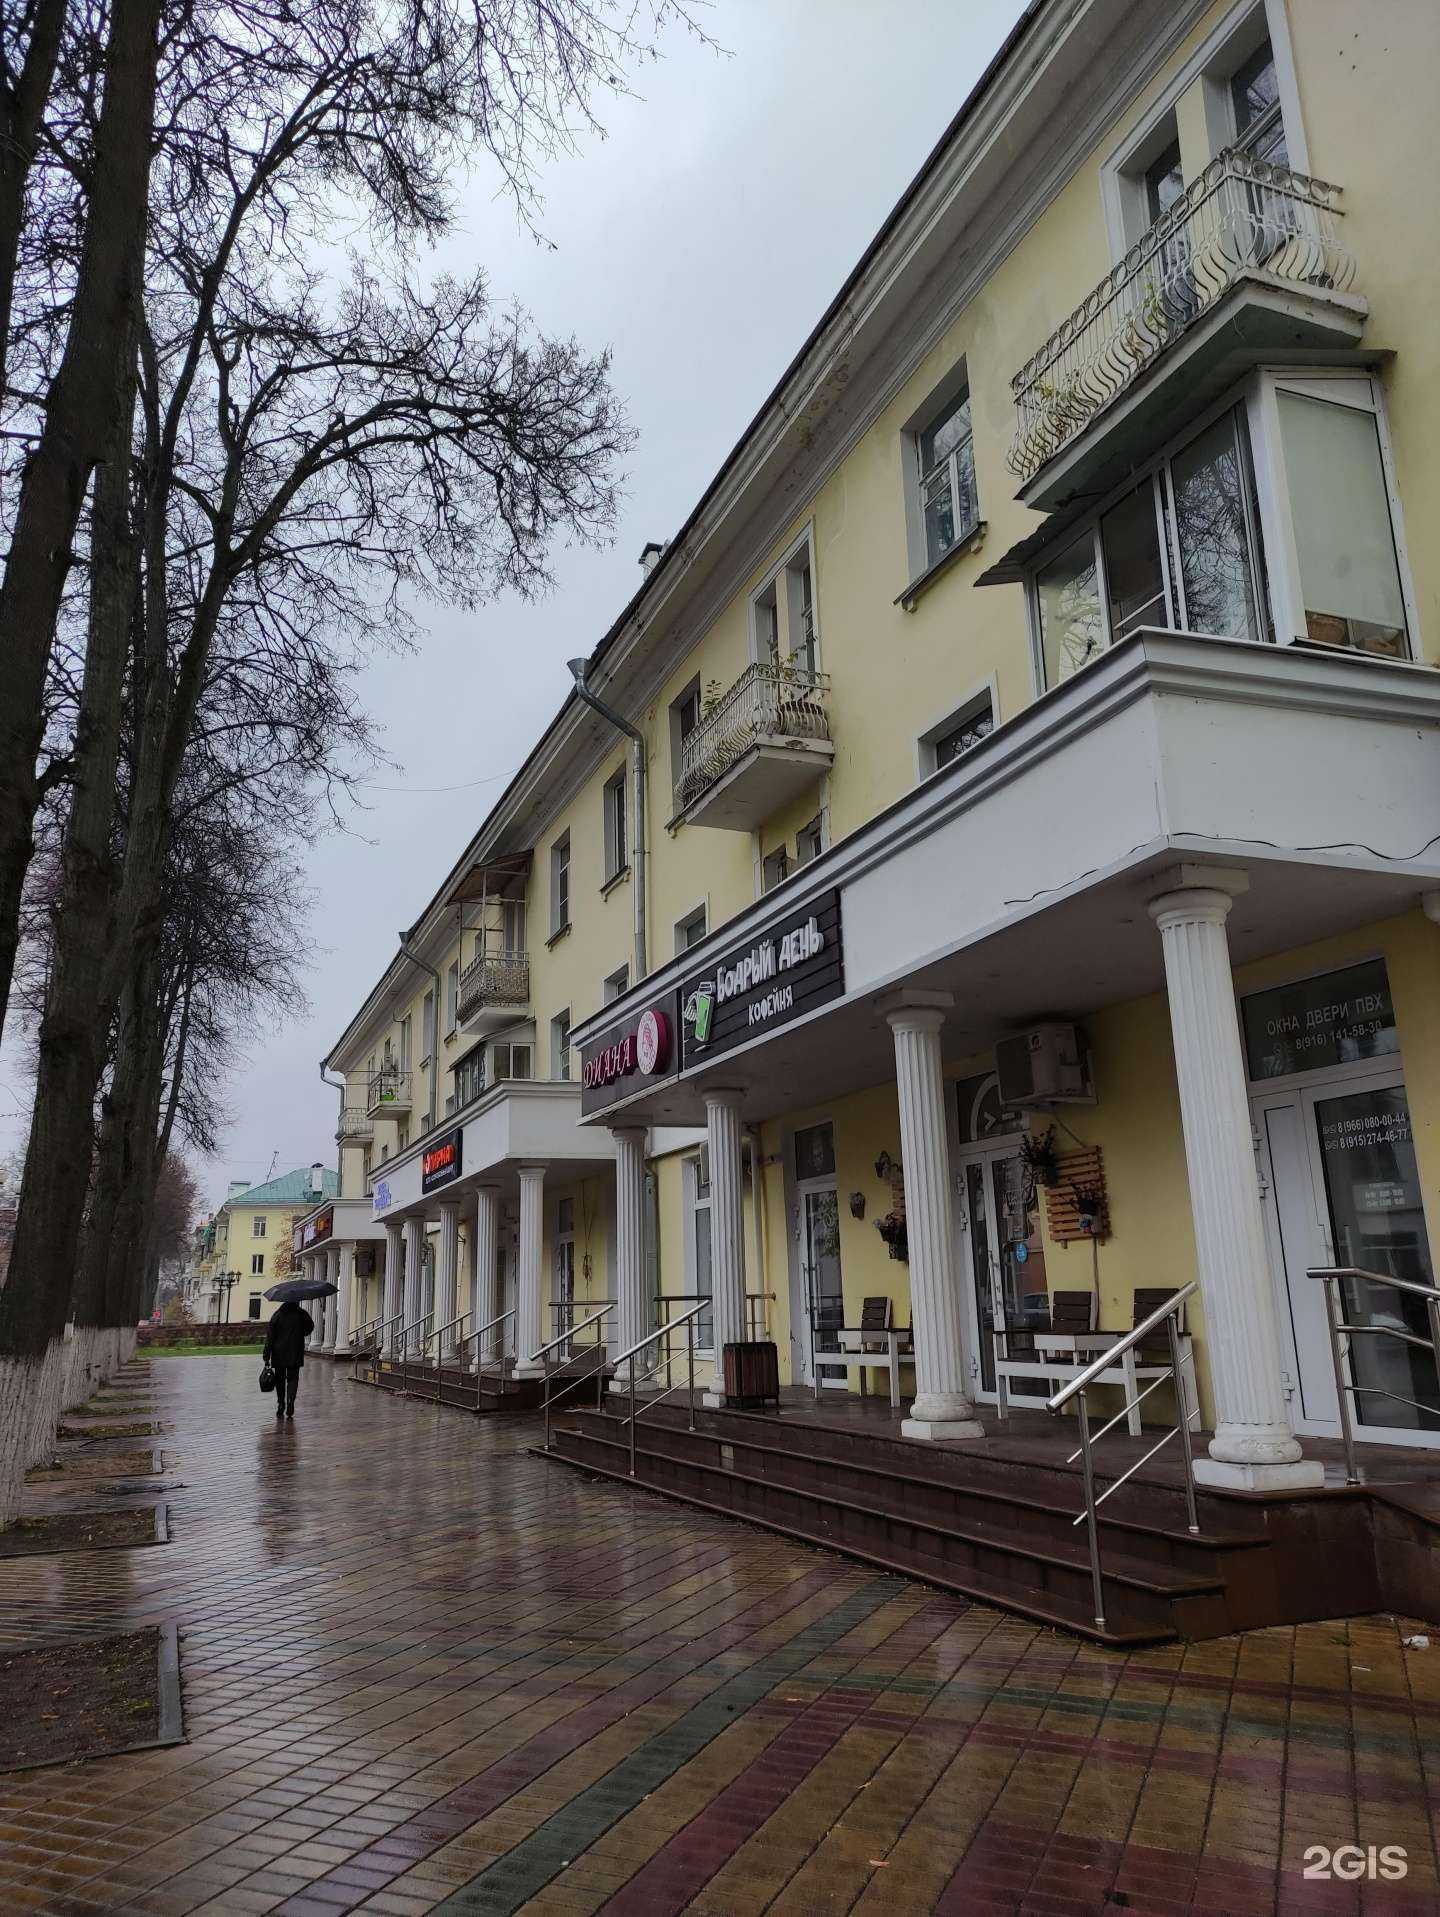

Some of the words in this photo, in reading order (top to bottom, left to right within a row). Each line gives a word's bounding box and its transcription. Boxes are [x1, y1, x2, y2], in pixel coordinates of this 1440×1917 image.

[778, 917, 824, 971] ДЕНЬ
[749, 985, 793, 1026] КОФЕЙНЯ
[1267, 1015, 1300, 1036] ОКНА
[1306, 1001, 1349, 1029] ДВЕРИ
[1355, 993, 1384, 1014] ПВХ
[584, 1038, 631, 1088] ДИАНА
